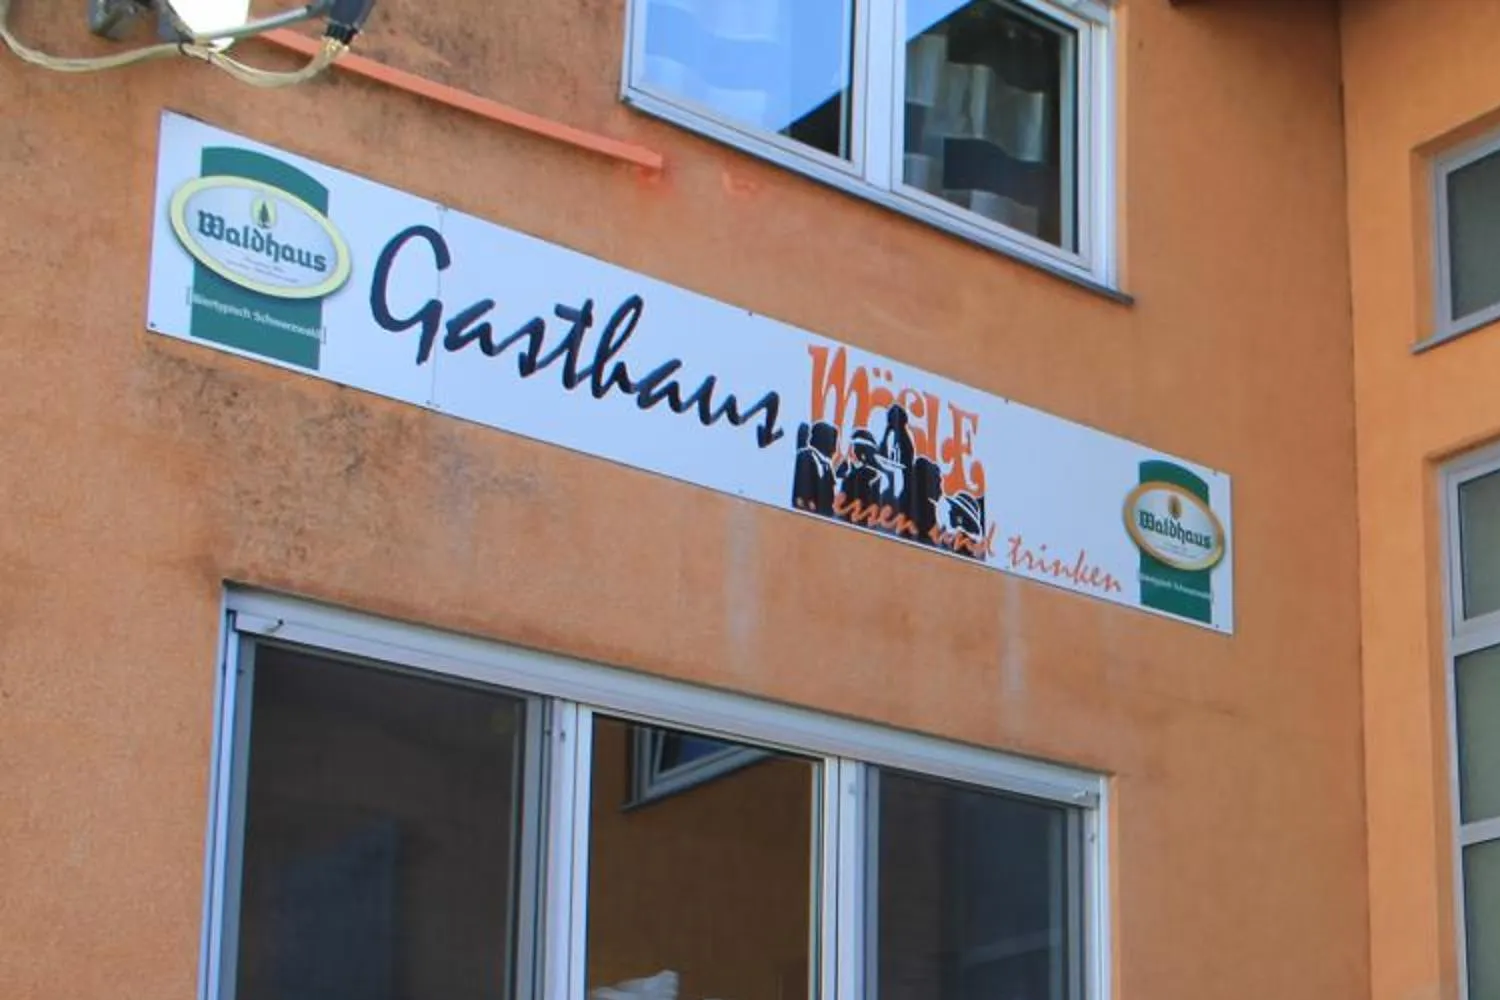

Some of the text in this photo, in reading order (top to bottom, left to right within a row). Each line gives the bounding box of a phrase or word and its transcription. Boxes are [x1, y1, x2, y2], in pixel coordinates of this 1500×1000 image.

[197, 210, 327, 273] Waldhaus
[370, 225, 784, 449] Gasthaus
[1138, 510, 1212, 550] Waldhaus
[1008, 534, 1122, 592] trinken
